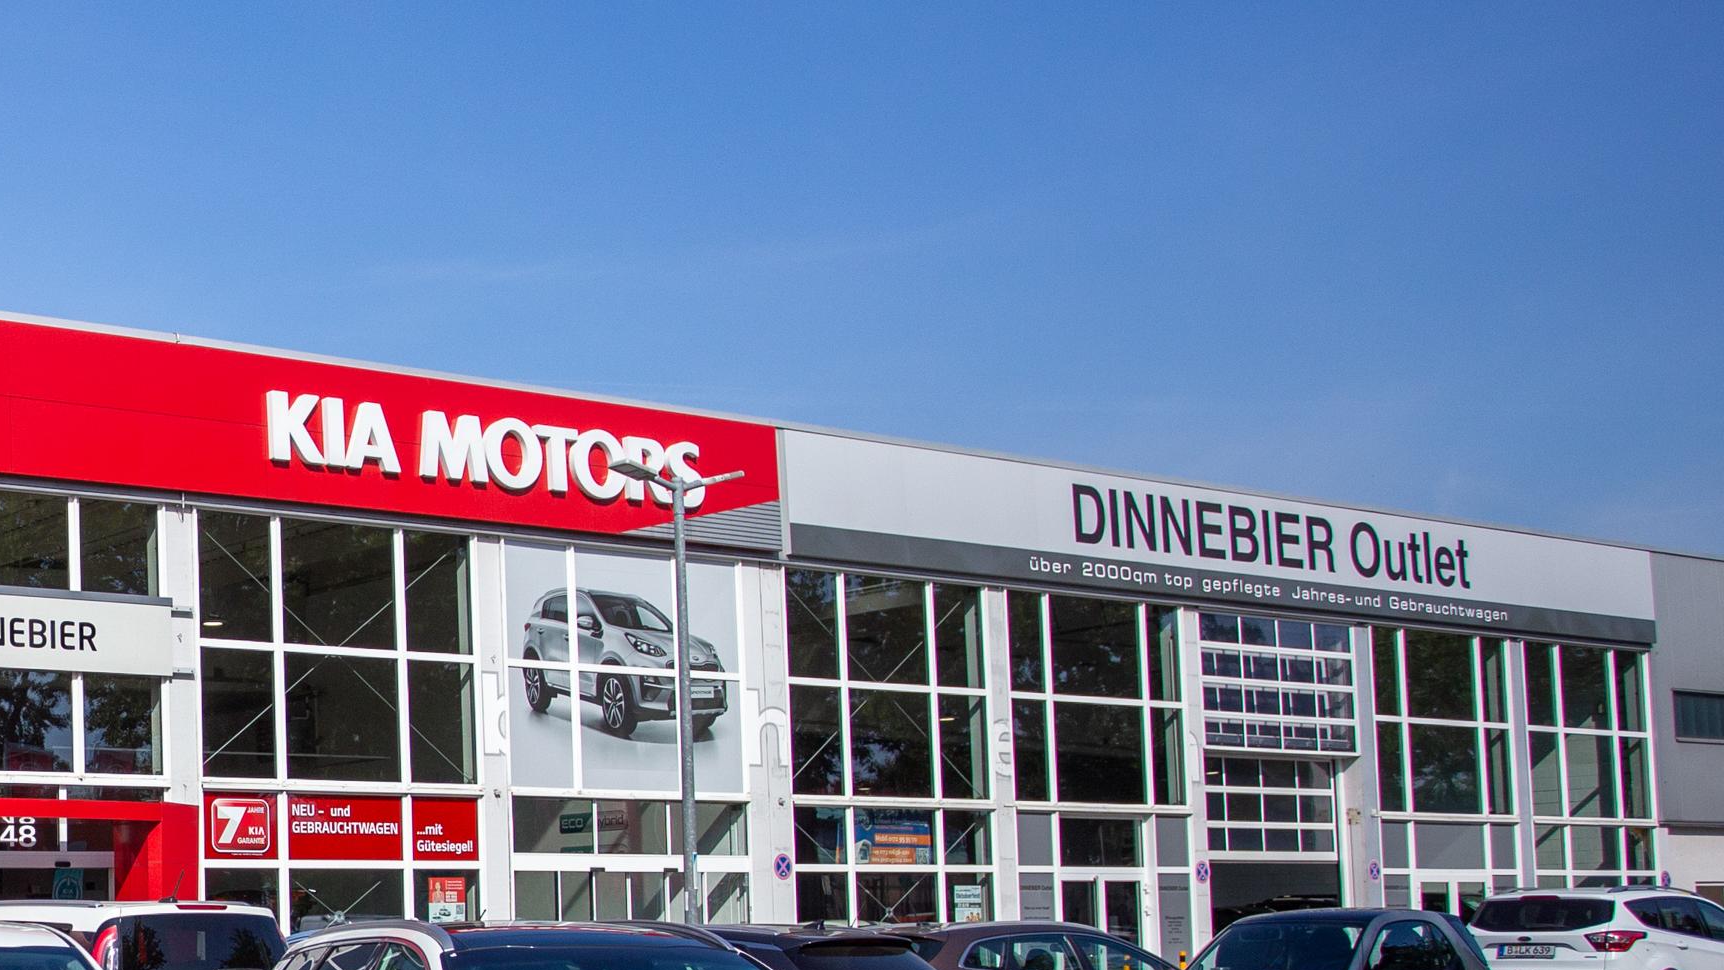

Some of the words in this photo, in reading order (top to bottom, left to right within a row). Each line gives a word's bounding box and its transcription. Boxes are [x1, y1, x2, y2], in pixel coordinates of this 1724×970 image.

[266, 390, 401, 475] KIA
[419, 410, 707, 510] MOTORS
[1072, 483, 1336, 574] DINNEBIER
[1349, 521, 1470, 590] Outlet
[1029, 556, 1072, 574] über
[1082, 562, 1157, 585] 2000qm
[1164, 573, 1193, 588] top
[1202, 578, 1281, 598] gepflegte
[1388, 596, 1508, 622] Gebrauchtwagen
[291, 804, 315, 816] NEU
[330, 805, 351, 816] und
[248, 826, 264, 835] KIA
[292, 821, 398, 835] GEBRAUCHTWAGEN
[416, 840, 473, 854] Gütesiegel!
